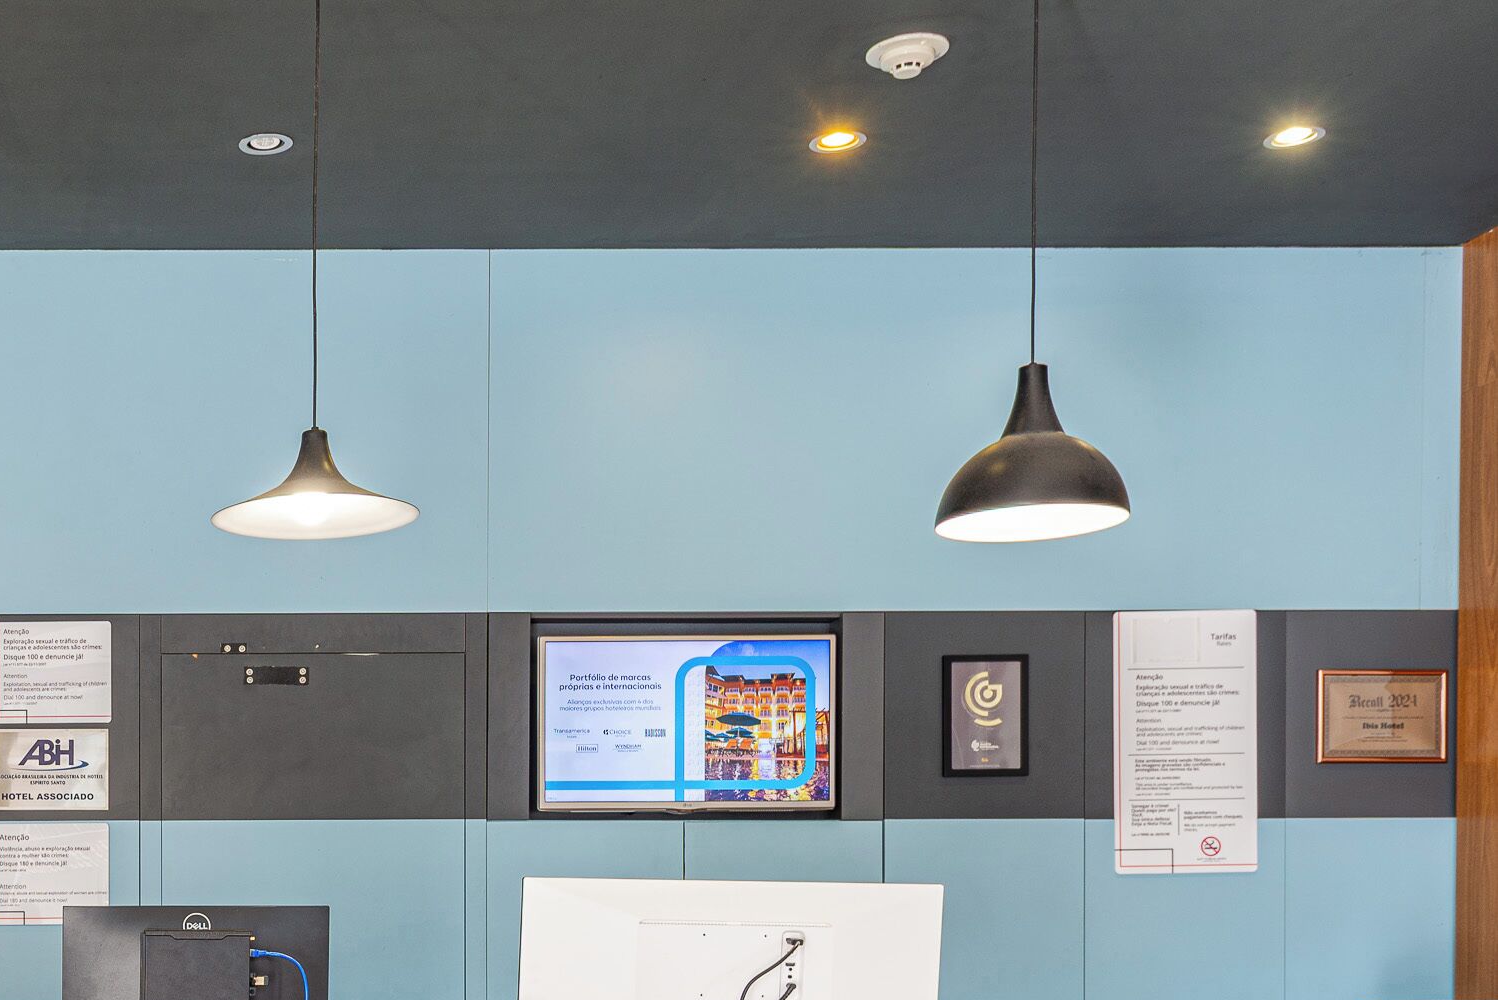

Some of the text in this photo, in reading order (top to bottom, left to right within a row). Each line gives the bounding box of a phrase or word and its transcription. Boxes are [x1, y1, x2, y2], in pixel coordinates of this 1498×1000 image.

[560, 683, 593, 691] próprias
[1388, 694, 1417, 708] 2024
[645, 729, 666, 737] RADISSON
[0, 834, 29, 842] Atenção
[187, 922, 208, 930] DELL
